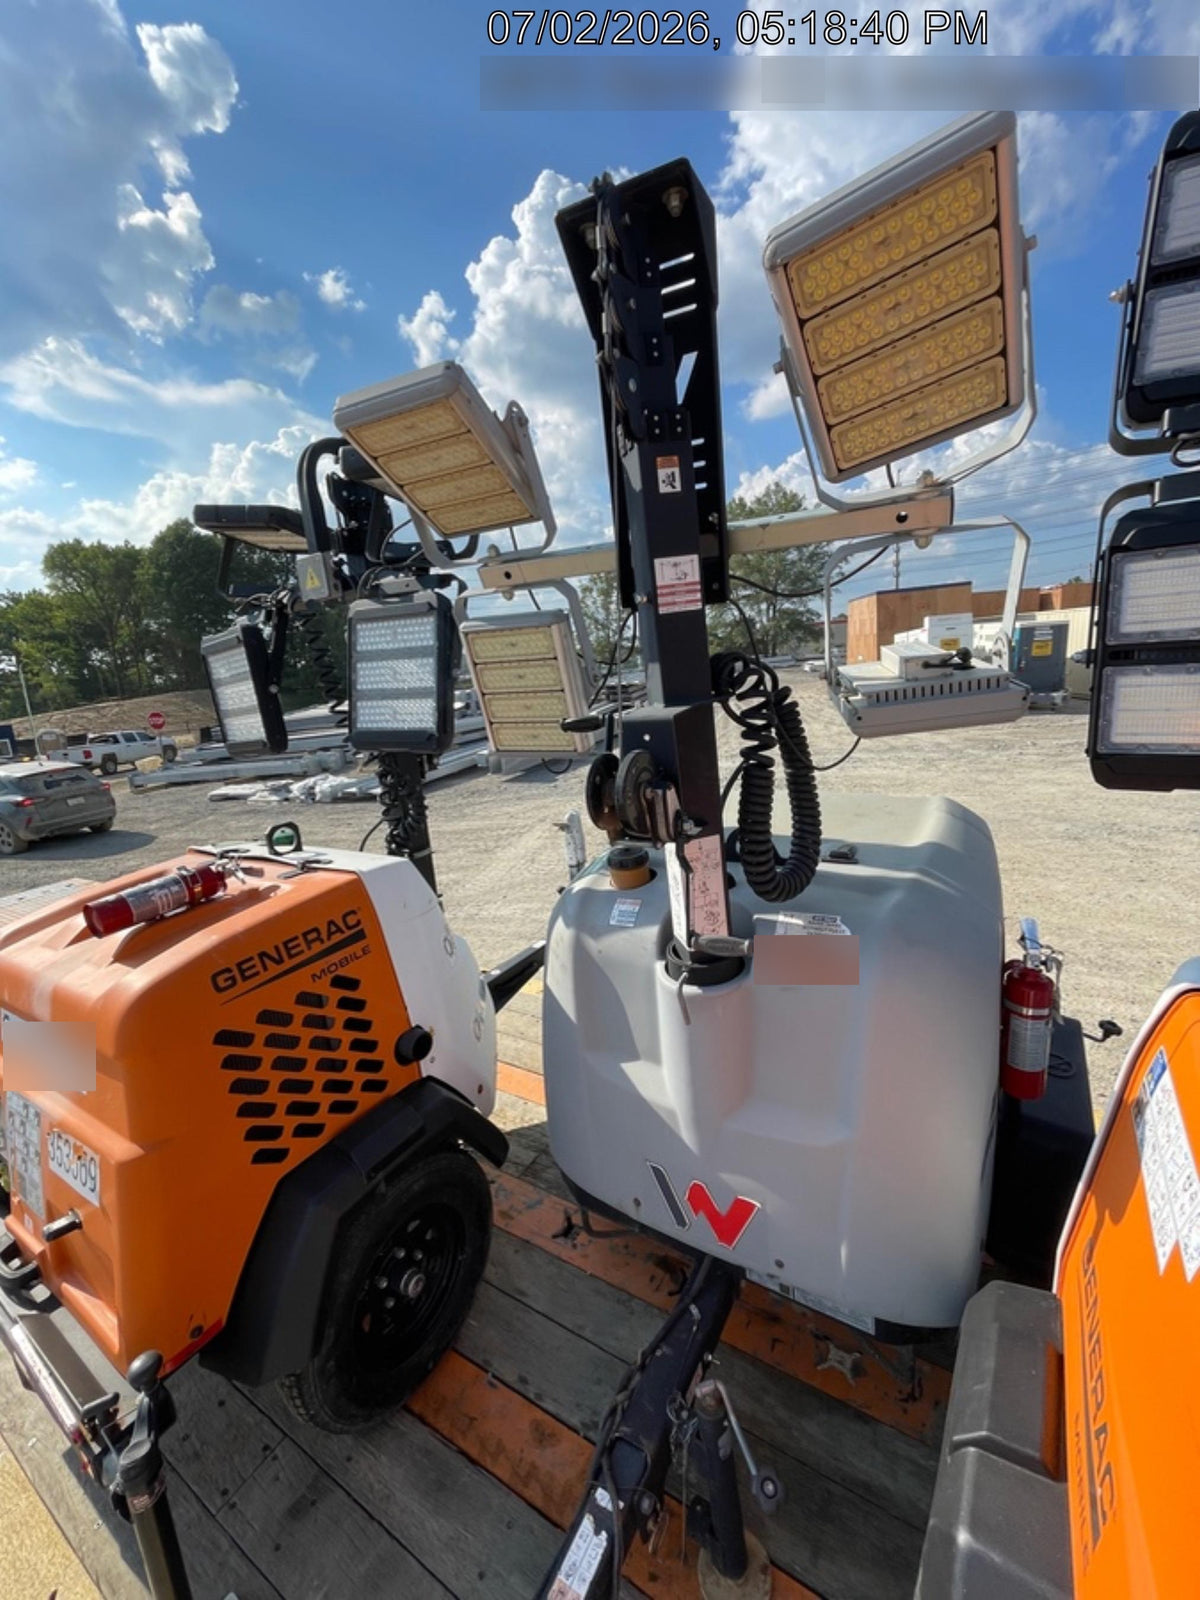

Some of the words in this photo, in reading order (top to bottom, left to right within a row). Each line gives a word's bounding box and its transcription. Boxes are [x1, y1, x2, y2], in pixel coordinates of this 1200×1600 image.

[210, 909, 361, 993] GENERAC
[310, 944, 371, 983] MOBILE
[1083, 1237, 1115, 1526] GENERAC
